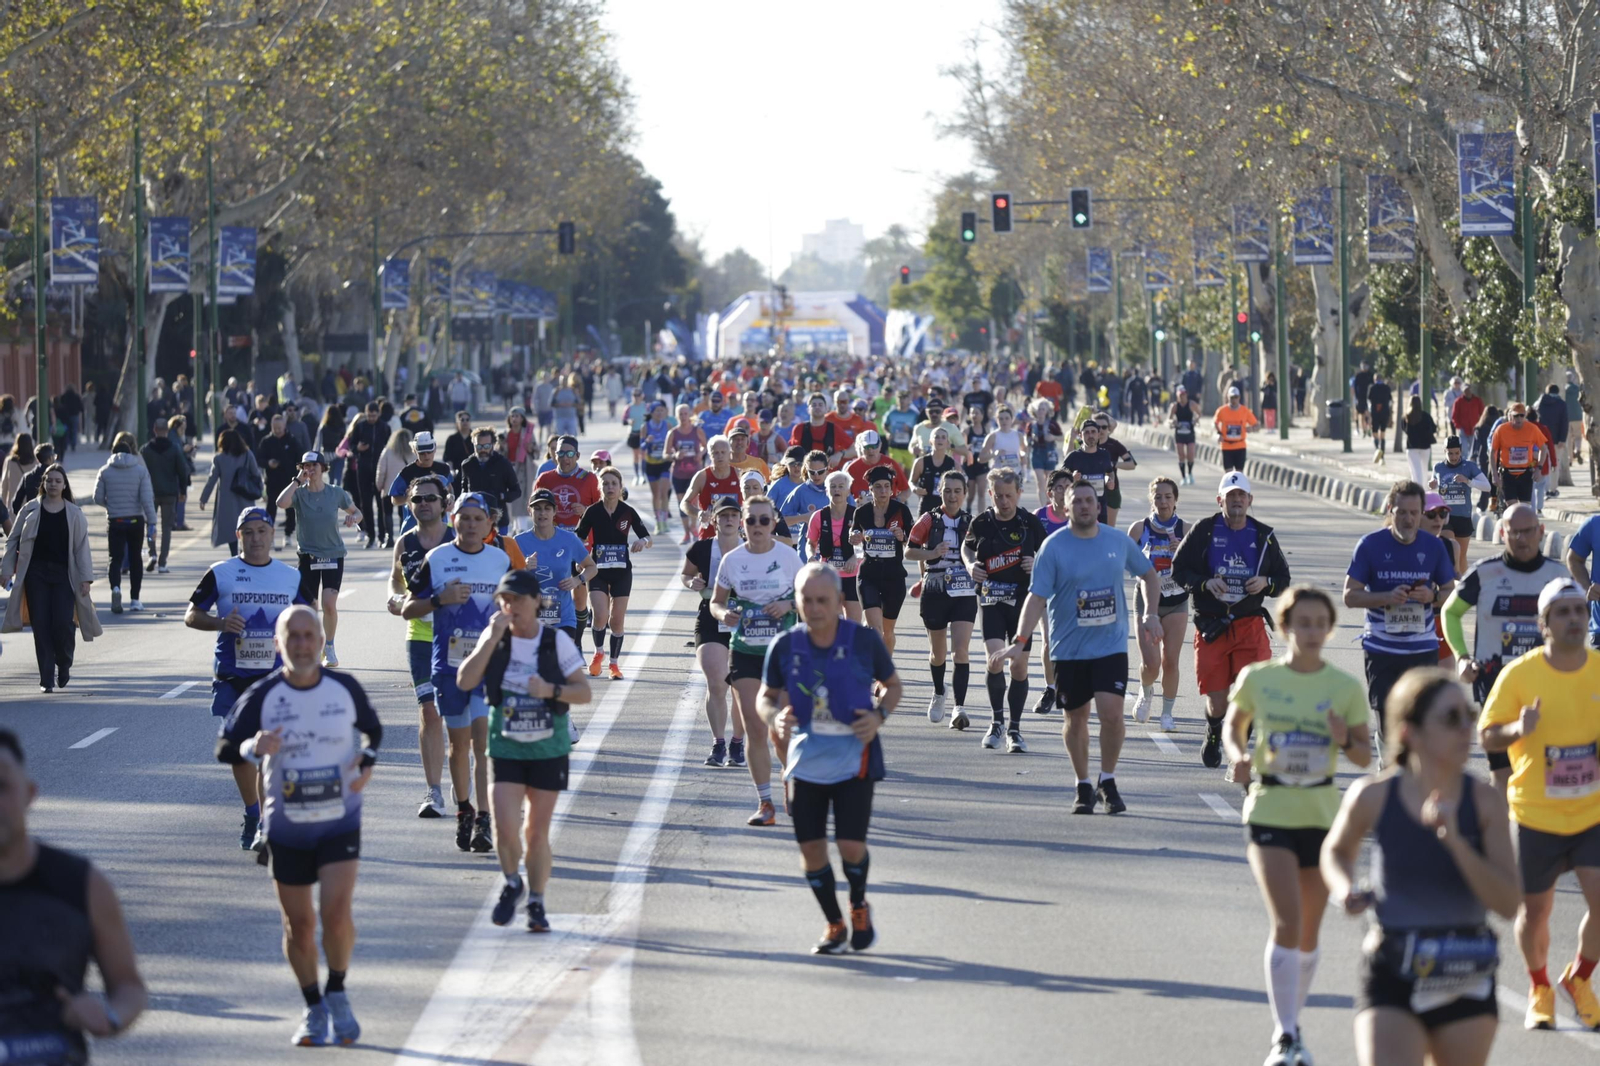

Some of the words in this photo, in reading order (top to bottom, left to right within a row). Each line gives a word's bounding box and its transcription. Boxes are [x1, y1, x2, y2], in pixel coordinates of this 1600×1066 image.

[865, 543, 896, 551] LAURENCE
[1227, 568, 1250, 576] ZURICH
[1377, 571, 1390, 580] U.S
[951, 581, 972, 590] CÉCILE
[1089, 588, 1111, 598] ZURICH
[231, 593, 290, 605] INDEPENDIENTES
[1080, 606, 1114, 618] SPRAGGY
[1390, 614, 1422, 623] JEAN-MI
[240, 650, 273, 659] SARCIAT
[510, 719, 547, 730] NOËLLE
